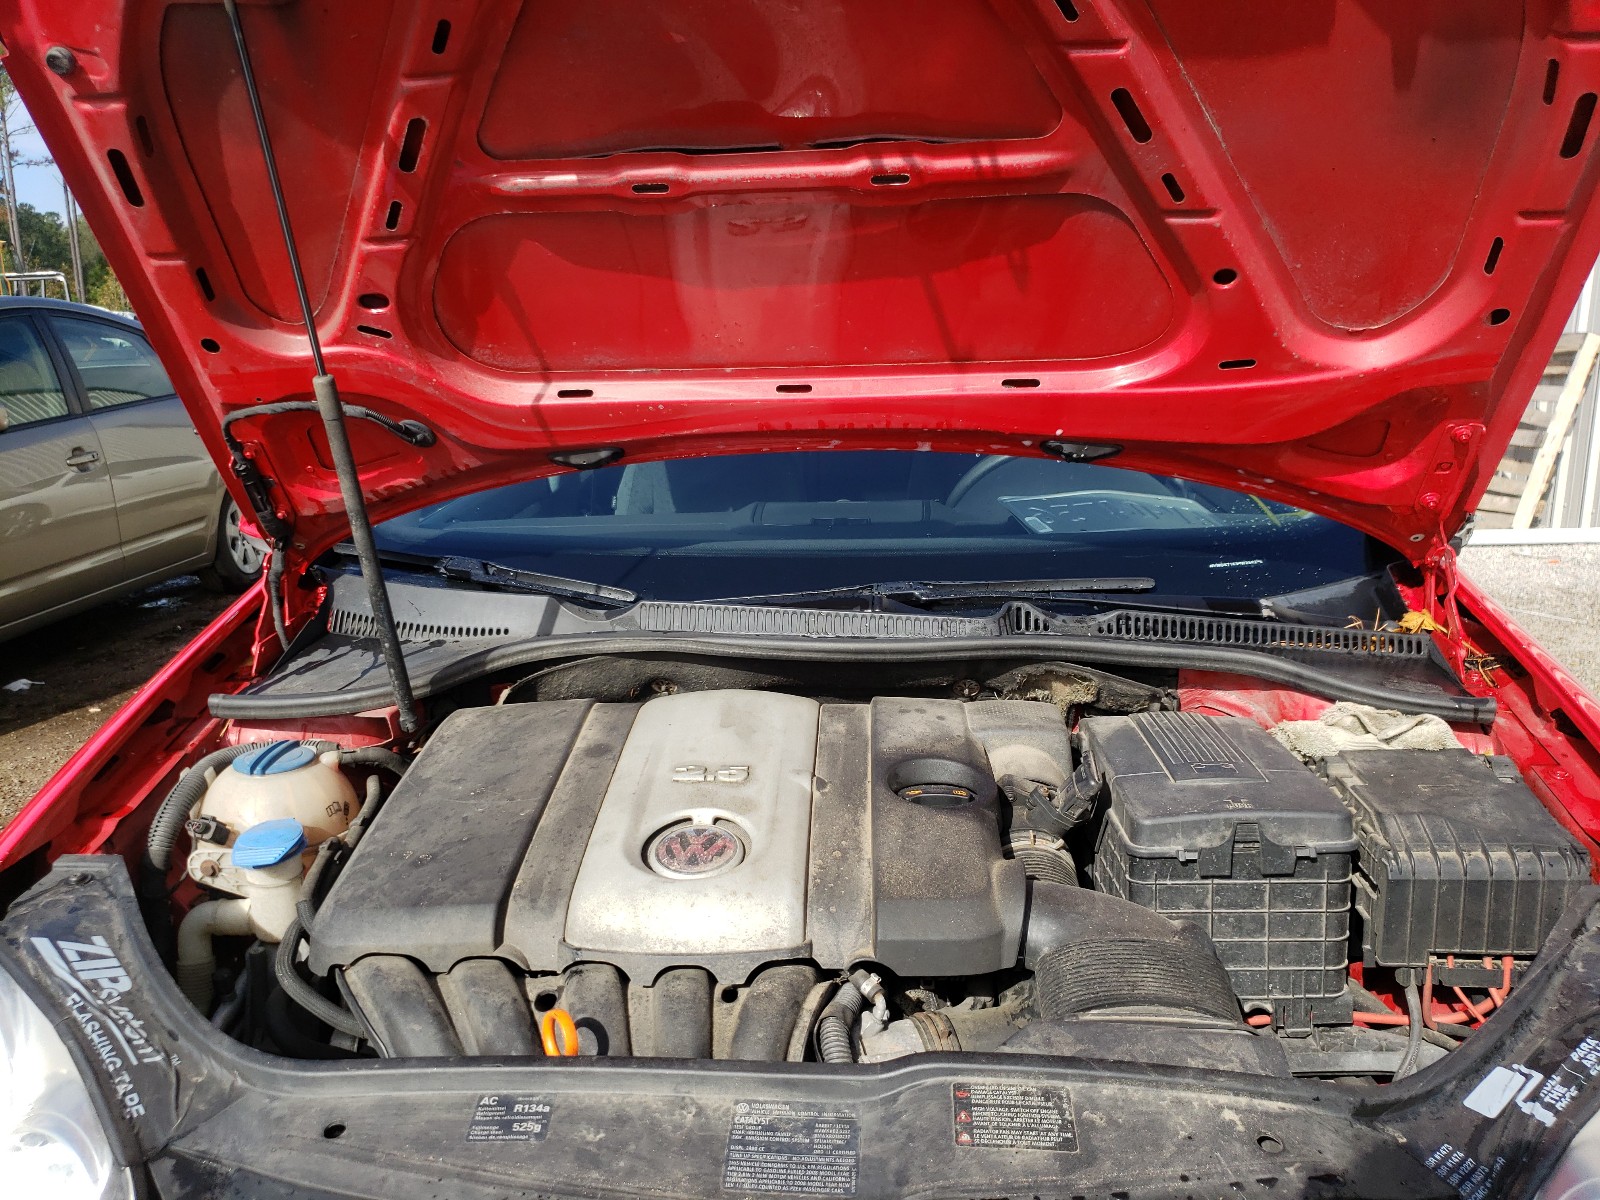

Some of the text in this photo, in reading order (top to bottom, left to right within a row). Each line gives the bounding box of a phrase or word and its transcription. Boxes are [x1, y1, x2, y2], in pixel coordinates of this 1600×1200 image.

[672, 764, 750, 783] 2.5
[56, 936, 133, 993] ZIP
[66, 992, 146, 1119] FLASHING TAPE
[480, 1096, 499, 1105] AC
[1544, 1084, 1568, 1104] THE
[513, 1104, 550, 1112] R134a
[512, 1122, 542, 1133] 525g
[734, 1116, 770, 1124] CATALYST
